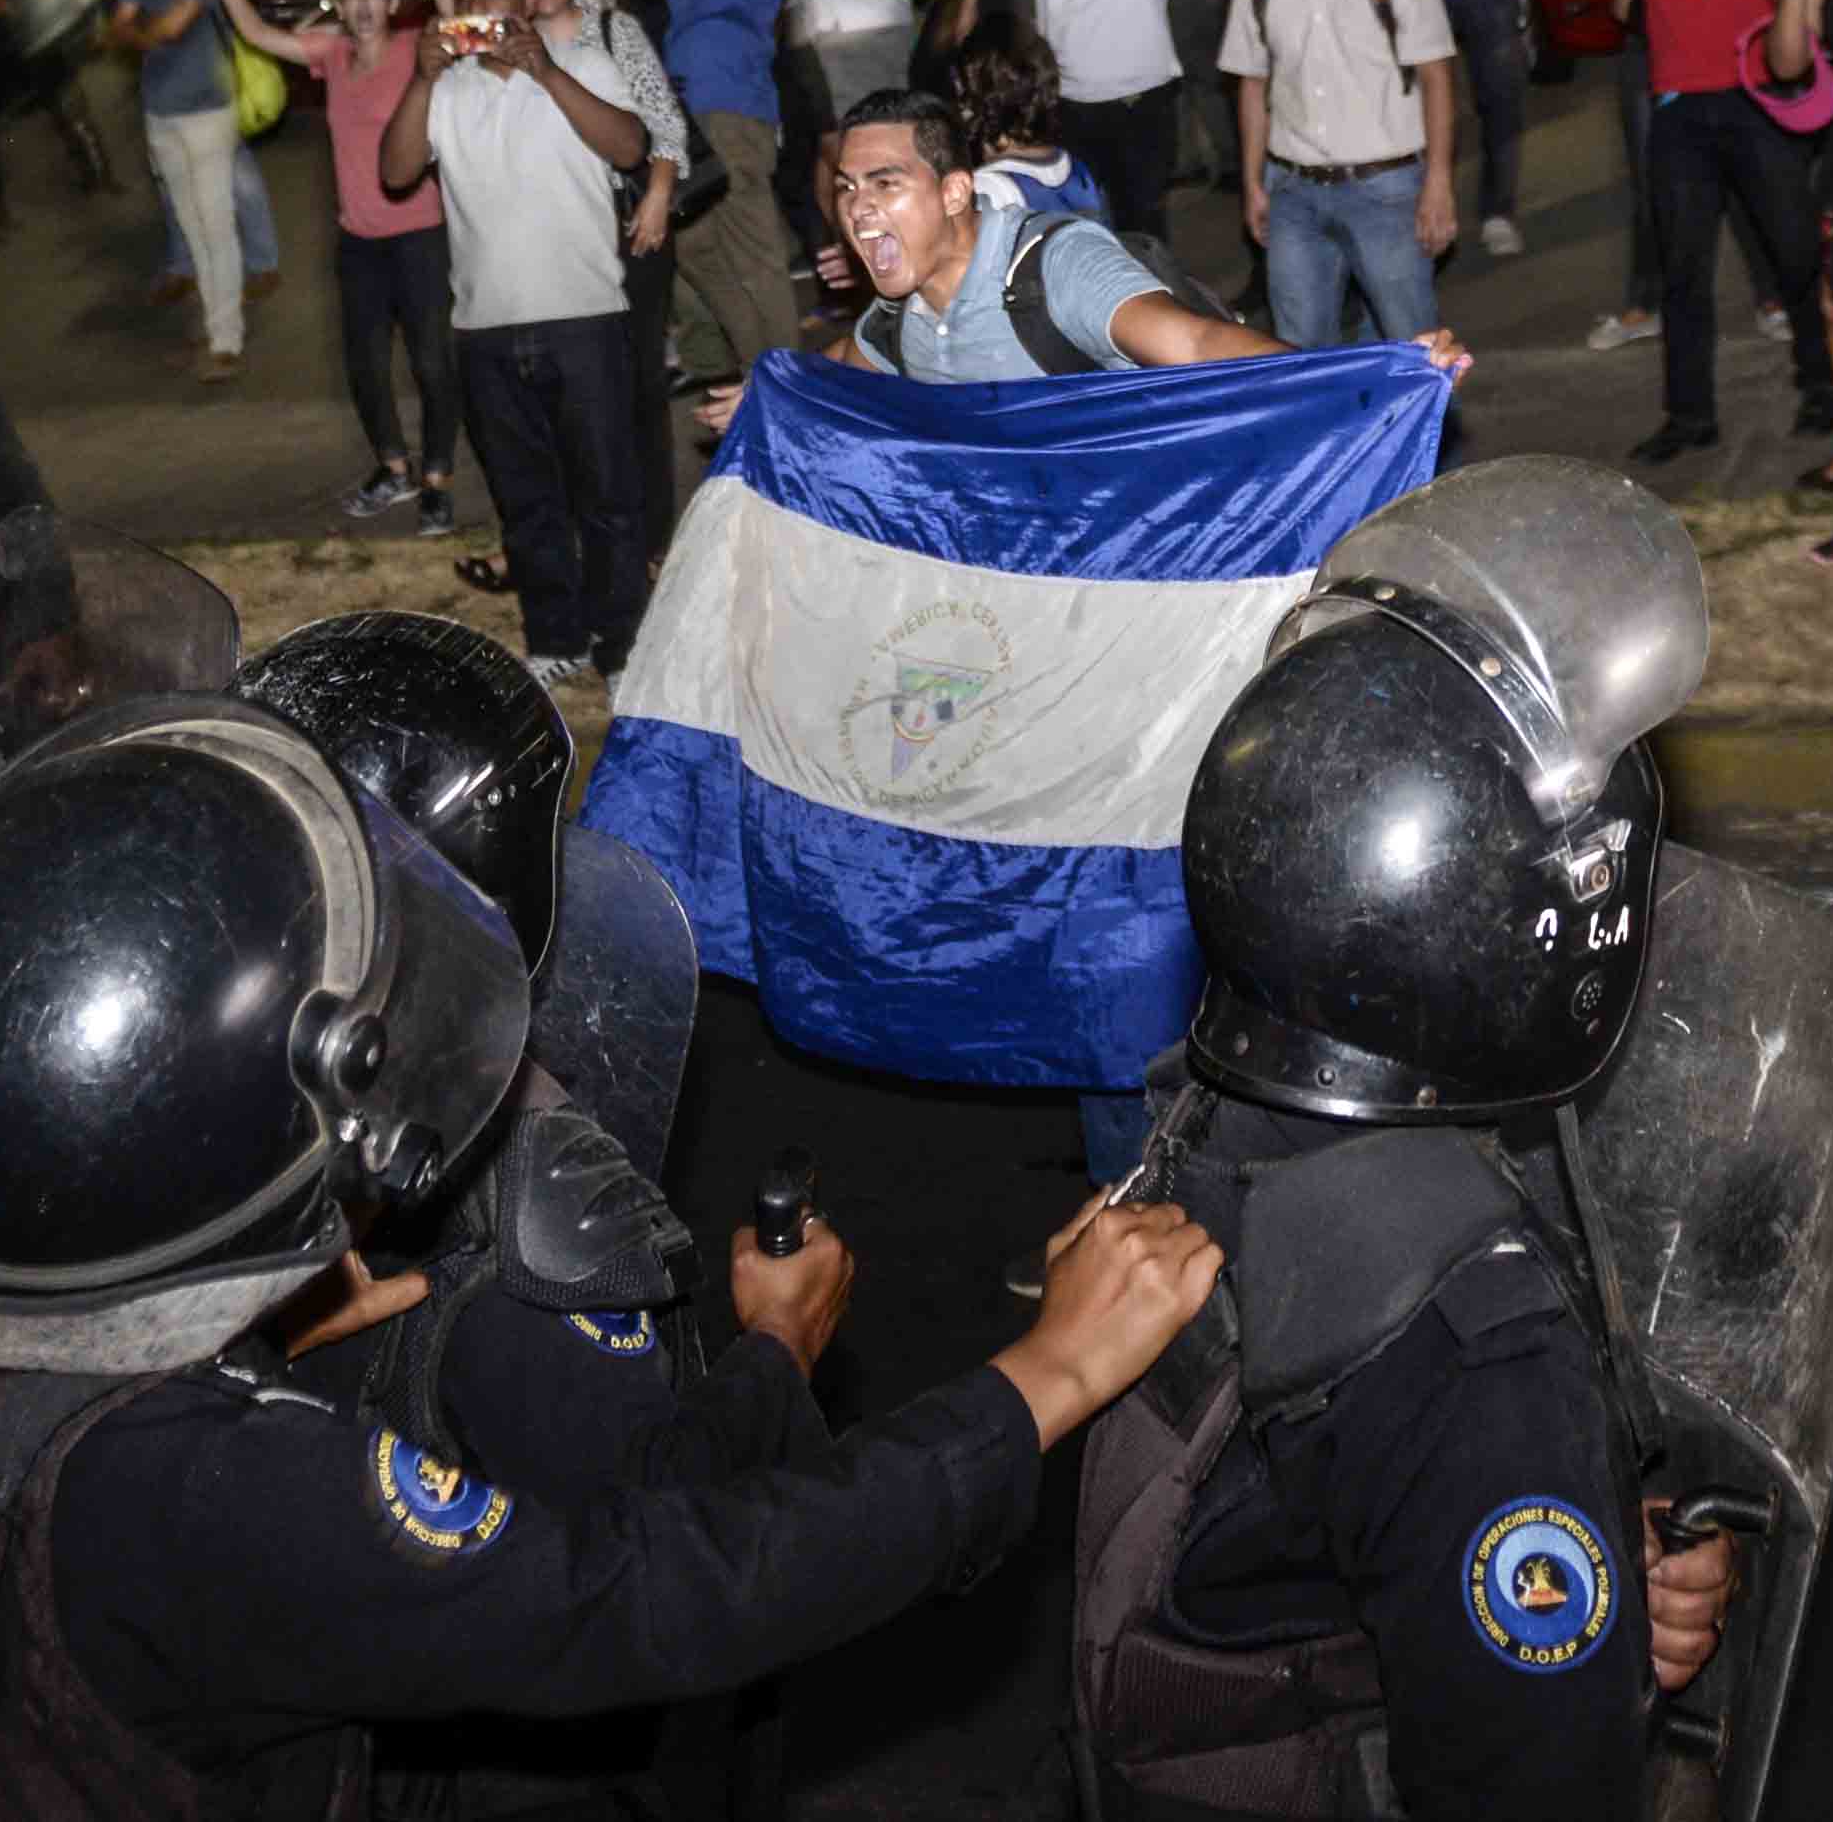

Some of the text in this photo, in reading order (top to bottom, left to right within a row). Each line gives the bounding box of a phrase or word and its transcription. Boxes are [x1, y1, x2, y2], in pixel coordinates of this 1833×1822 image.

[1471, 1507, 1611, 1649] DIRECCION DE OPERACIONES ESPECIALES POLICIALES
